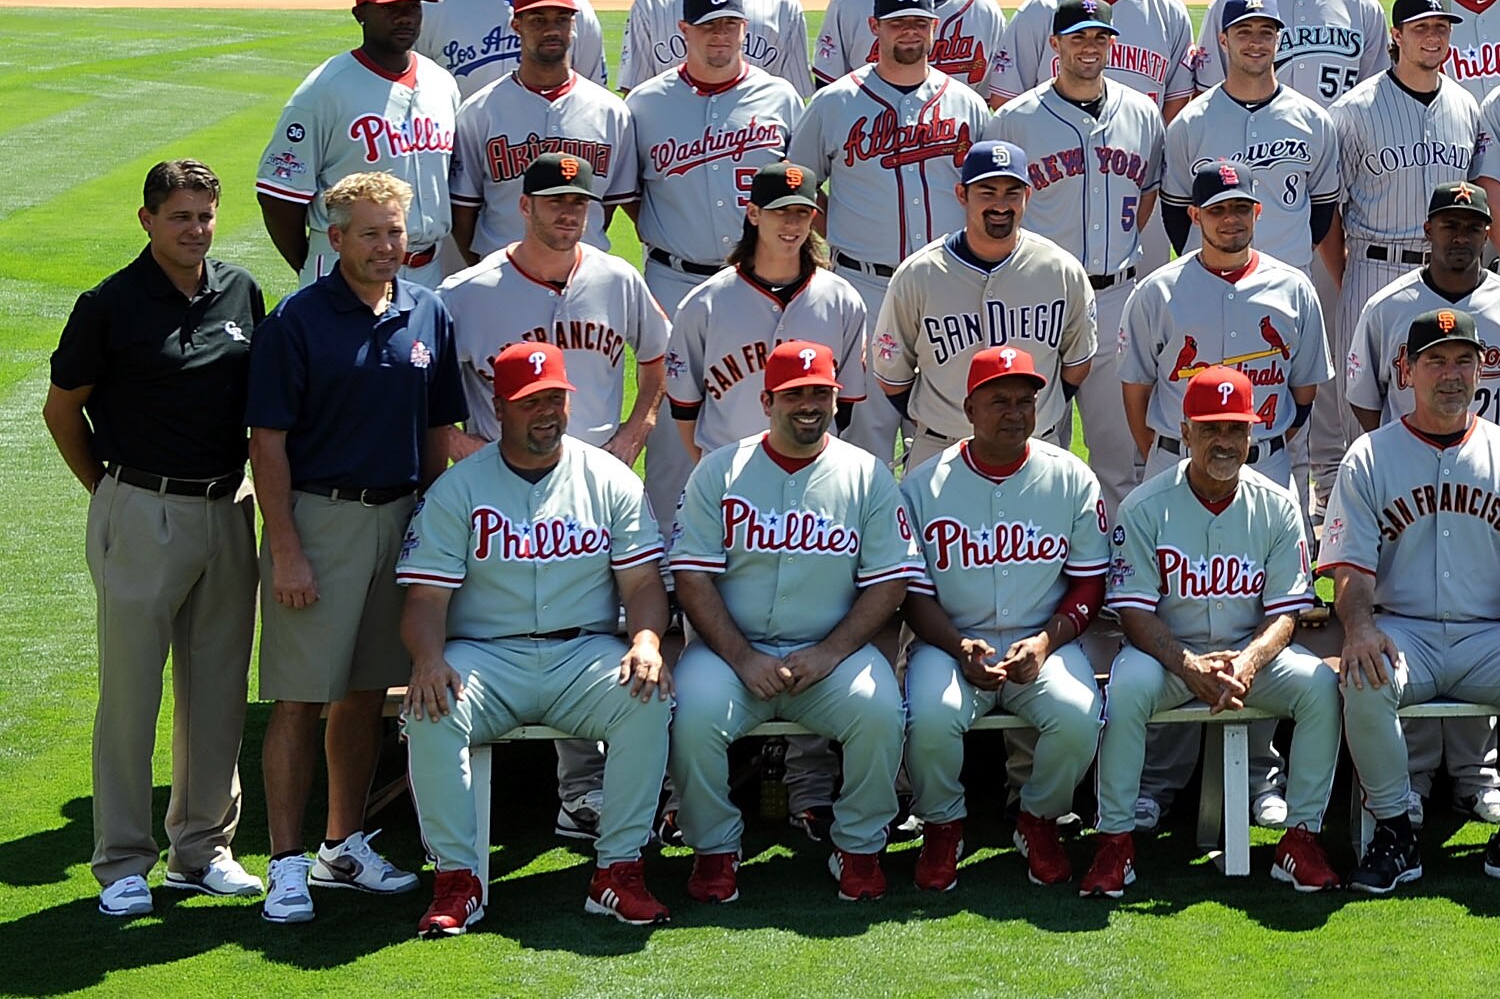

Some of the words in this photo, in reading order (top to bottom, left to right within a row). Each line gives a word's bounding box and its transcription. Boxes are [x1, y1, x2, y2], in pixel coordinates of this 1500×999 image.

[442, 40, 475, 71] Los
[654, 34, 778, 68] COADO
[1279, 25, 1363, 56] ARLINS
[1318, 64, 1358, 100] 55
[288, 126, 303, 139] 36
[350, 112, 454, 164] Phillie
[650, 116, 785, 178] Washington
[844, 103, 957, 168] Atlanta
[1028, 147, 1086, 190] NEW
[1094, 146, 1150, 186] YOR
[1365, 140, 1471, 177] COLORAD
[735, 168, 757, 209] 5
[1283, 175, 1299, 205] 8
[1121, 197, 1138, 232] 5
[924, 313, 983, 365] SAN
[986, 299, 1067, 349] DIEGO
[529, 351, 547, 374] P
[799, 349, 818, 370] P
[999, 349, 1017, 368] P
[1217, 382, 1234, 405] P
[472, 507, 610, 560] Phillies
[722, 498, 858, 554] Phillies
[1096, 499, 1108, 533] 8
[1379, 497, 1409, 542] SAN
[924, 519, 1068, 570] Phillies
[1114, 530, 1123, 542] 36
[1157, 547, 1265, 599] Phillie
